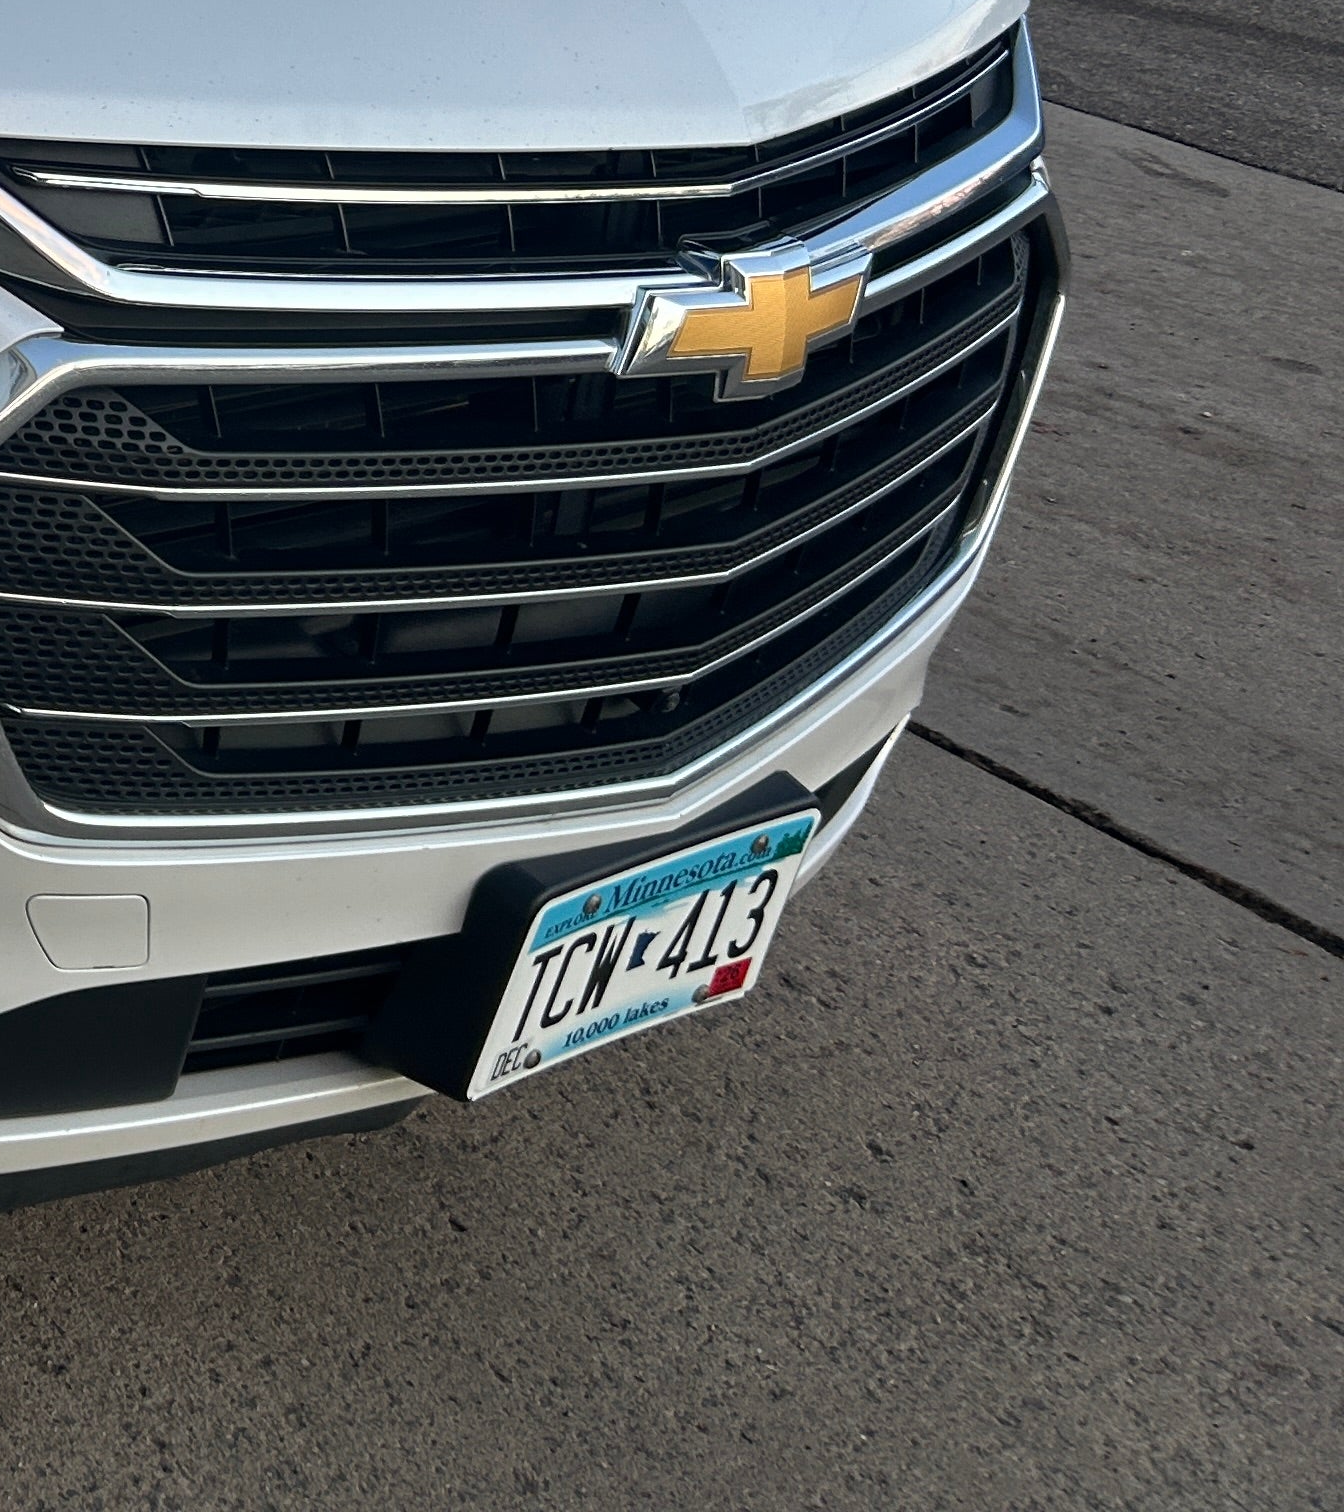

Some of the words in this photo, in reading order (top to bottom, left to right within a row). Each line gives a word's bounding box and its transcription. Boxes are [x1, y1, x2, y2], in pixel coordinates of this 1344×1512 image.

[511, 915, 637, 1043] TCW
[655, 868, 779, 979] 413
[563, 1013, 620, 1048] 10,000
[622, 997, 670, 1025] lakes
[490, 1042, 529, 1082] DEC
